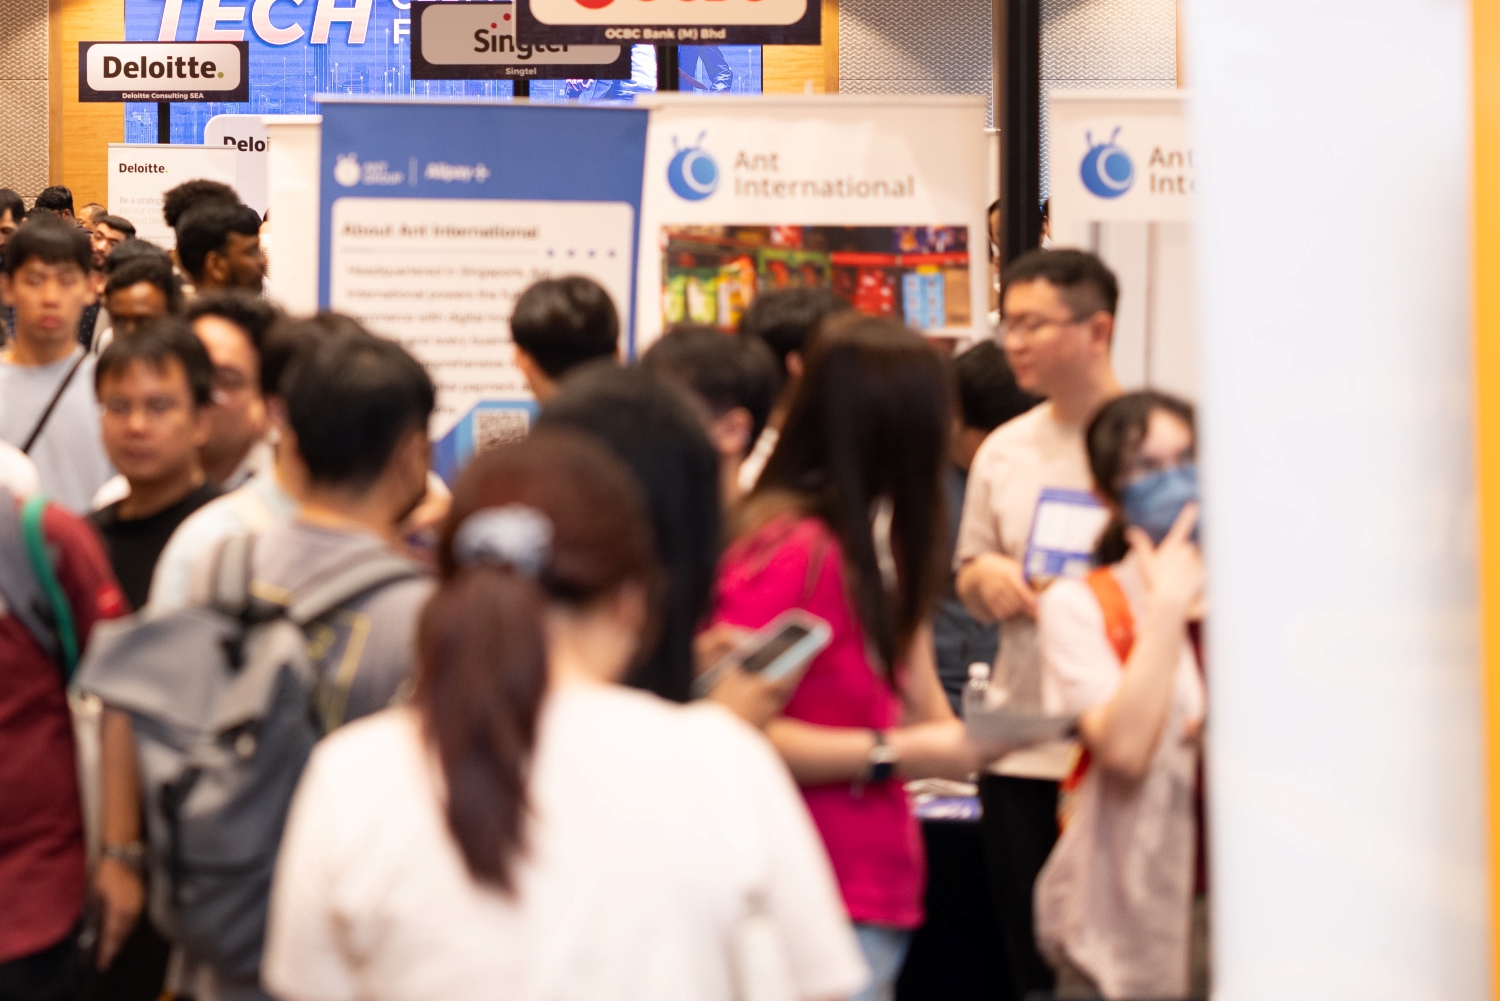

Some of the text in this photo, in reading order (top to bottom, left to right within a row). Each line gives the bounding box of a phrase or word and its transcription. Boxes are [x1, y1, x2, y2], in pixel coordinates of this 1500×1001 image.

[604, 28, 726, 42] OCBC Bank (M) Bhd
[102, 55, 225, 79] Deloitte.
[505, 67, 537, 76] Singtel
[122, 92, 204, 101] Deloitte Consulting SEA
[119, 162, 169, 174] Deloitte.
[733, 150, 779, 172] Ant
[733, 175, 915, 199] International
